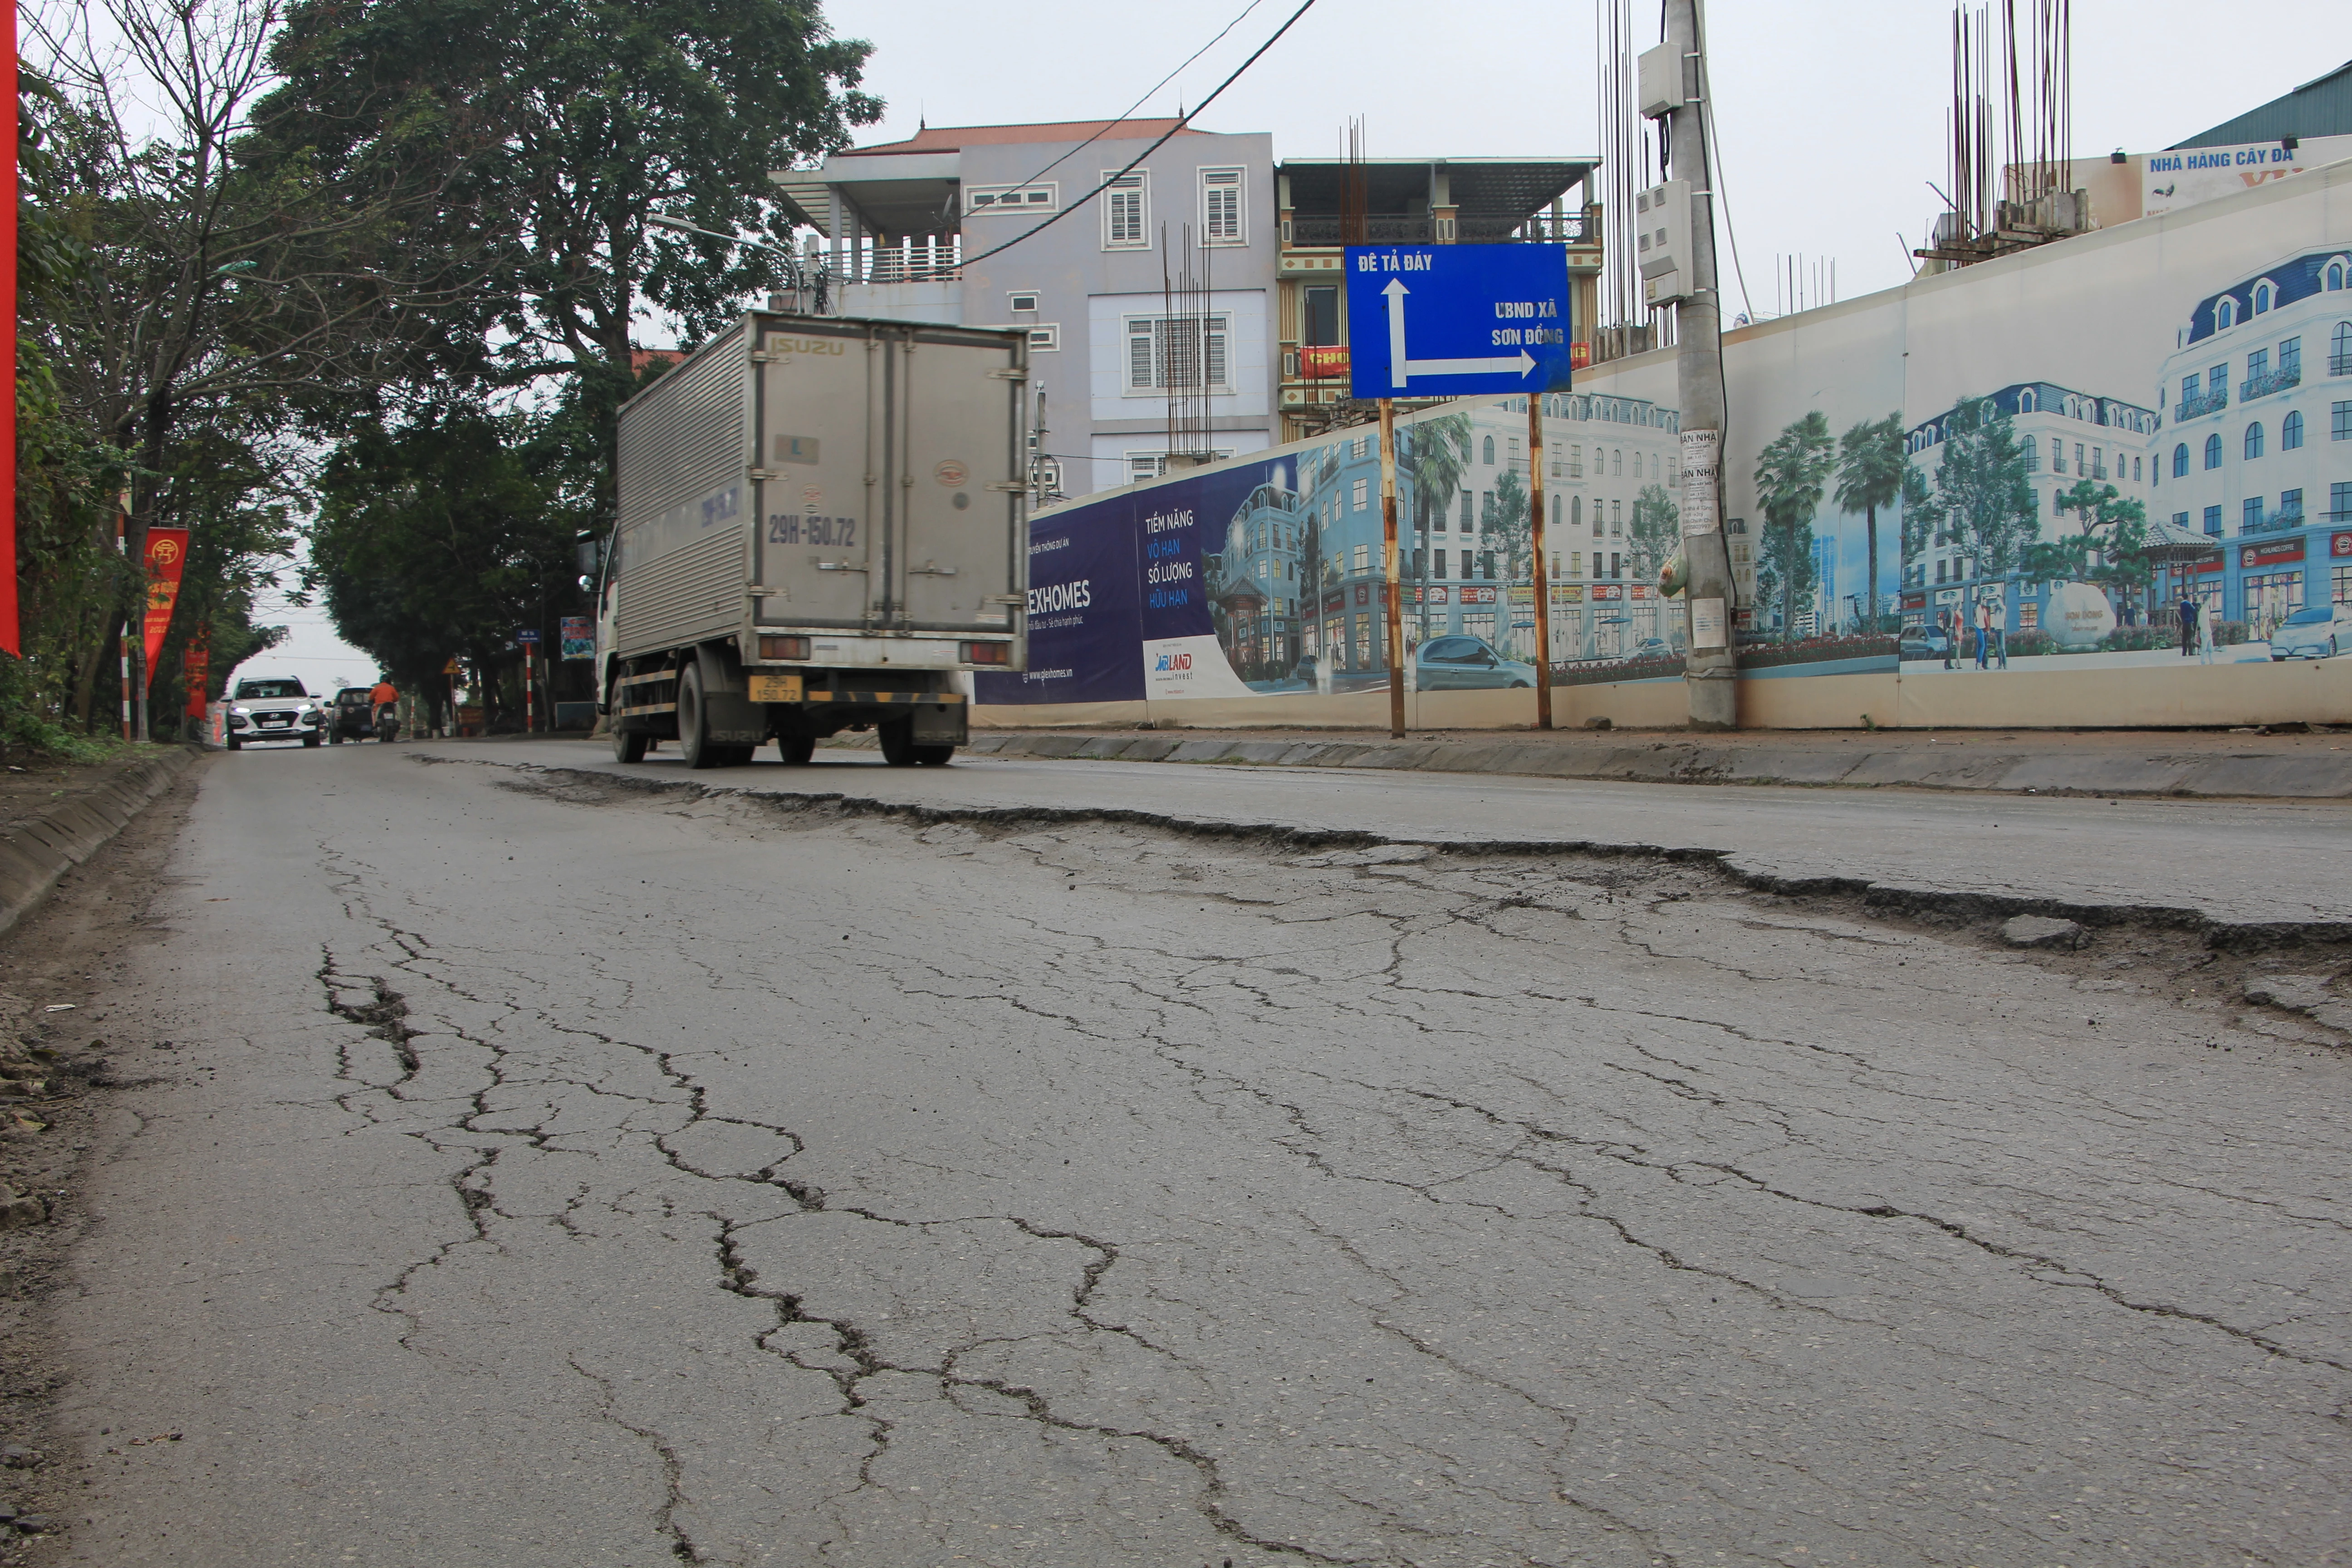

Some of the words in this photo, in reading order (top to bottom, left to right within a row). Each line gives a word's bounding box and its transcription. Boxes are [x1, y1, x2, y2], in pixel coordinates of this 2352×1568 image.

[2150, 154, 2182, 172] NHÀ
[2187, 152, 2230, 169] HÀNG
[2236, 148, 2267, 165] CÂY
[1358, 252, 1377, 272] ĐÊ
[1382, 249, 1400, 271] TẢ
[1404, 250, 1432, 271] ĐÁY
[1495, 302, 1534, 318] UBND
[1538, 298, 1557, 318] XÃ
[1492, 328, 1521, 346] SƠN
[1525, 323, 1563, 345] ĐỒNG
[771, 337, 844, 356] ISUZU
[1681, 433, 1693, 444] BÁN
[1697, 431, 1716, 441] NHÀ
[1697, 466, 1715, 477] NHÀ
[769, 514, 856, 547] 29H-150.72
[1146, 511, 1165, 534] TIỀM
[1167, 508, 1193, 530] NĂNG
[1028, 542, 1041, 555] RUYỀN
[1063, 536, 1069, 547] ÁN
[1147, 538, 1160, 559] VÔ
[1161, 538, 1180, 559] HẠN
[1148, 561, 1160, 584] SỐ
[1162, 562, 1192, 584] LƯỢNG
[1025, 579, 1091, 615] EXHOMES
[1149, 588, 1166, 609] HỮU
[1169, 589, 1188, 609] HẠN
[764, 676, 788, 688] 29H
[1029, 667, 1073, 681] www.glexhomes.vn
[1172, 671, 1192, 680] invest
[757, 689, 797, 701] 150.72
